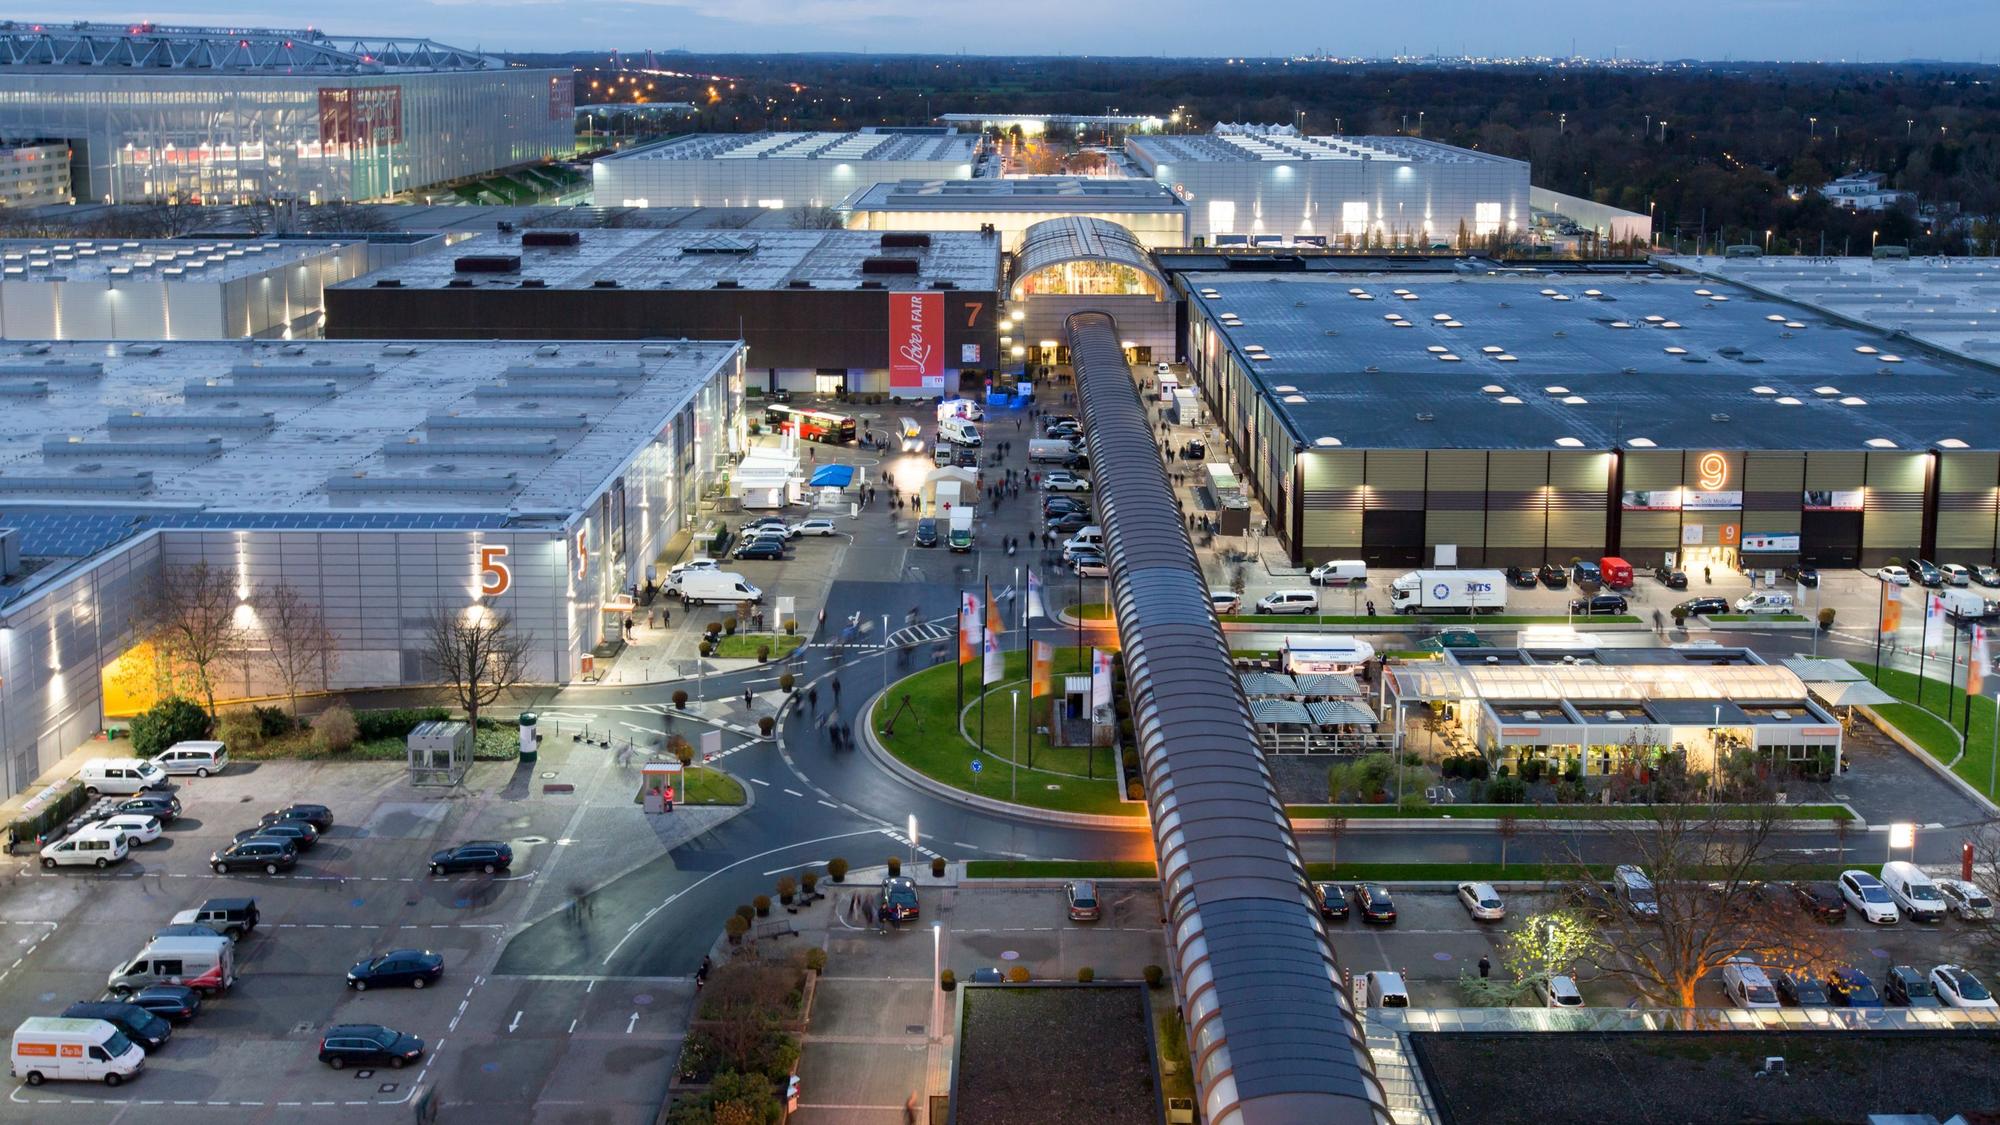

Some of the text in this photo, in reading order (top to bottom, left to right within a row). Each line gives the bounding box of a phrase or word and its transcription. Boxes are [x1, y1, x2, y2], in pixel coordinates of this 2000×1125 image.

[357, 89, 397, 121] ESPRIT
[911, 296, 922, 322] FAIR
[964, 302, 983, 327] 7
[911, 324, 922, 333] A
[900, 333, 931, 374] Love
[1700, 453, 1727, 490] 9
[1726, 526, 1735, 540] 9
[480, 545, 511, 596] 5
[1467, 583, 1491, 592] MTS
